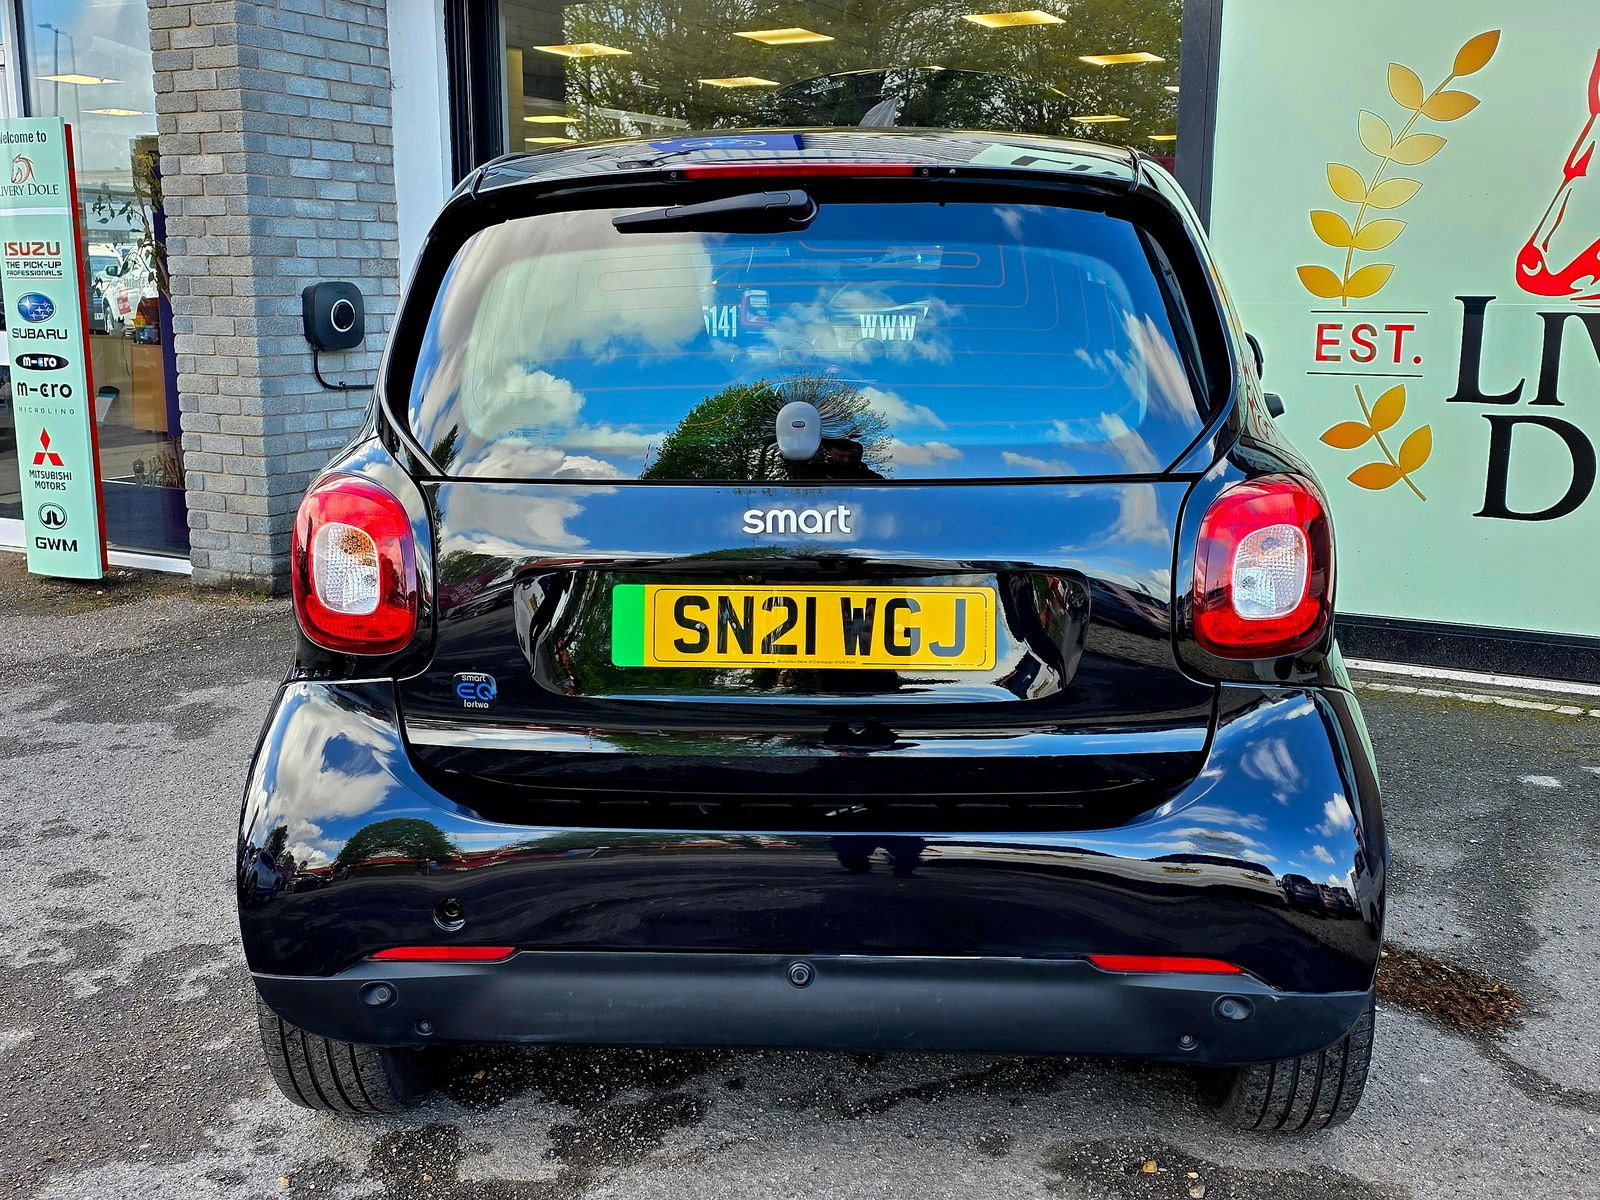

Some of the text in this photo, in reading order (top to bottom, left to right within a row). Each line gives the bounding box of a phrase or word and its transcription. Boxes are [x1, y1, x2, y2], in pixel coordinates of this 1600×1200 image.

[0, 130, 47, 144] elcome to
[28, 183, 60, 196] DOLE
[4, 241, 61, 256] ISUZU
[6, 261, 62, 269] THE PICK-UP
[6, 269, 63, 277] PROFESSIONALS
[12, 327, 68, 340] SUBARU
[1315, 323, 1422, 364] EST.
[18, 406, 75, 415] MICROLINO
[29, 469, 72, 480] MITSUBISHI
[34, 480, 67, 491] MOTORS
[742, 505, 852, 534] smart
[35, 536, 78, 552] GWM
[673, 595, 817, 656] SN21
[840, 597, 966, 658] WGJ
[456, 682, 497, 700] EQ
[463, 699, 490, 709] fortwo
